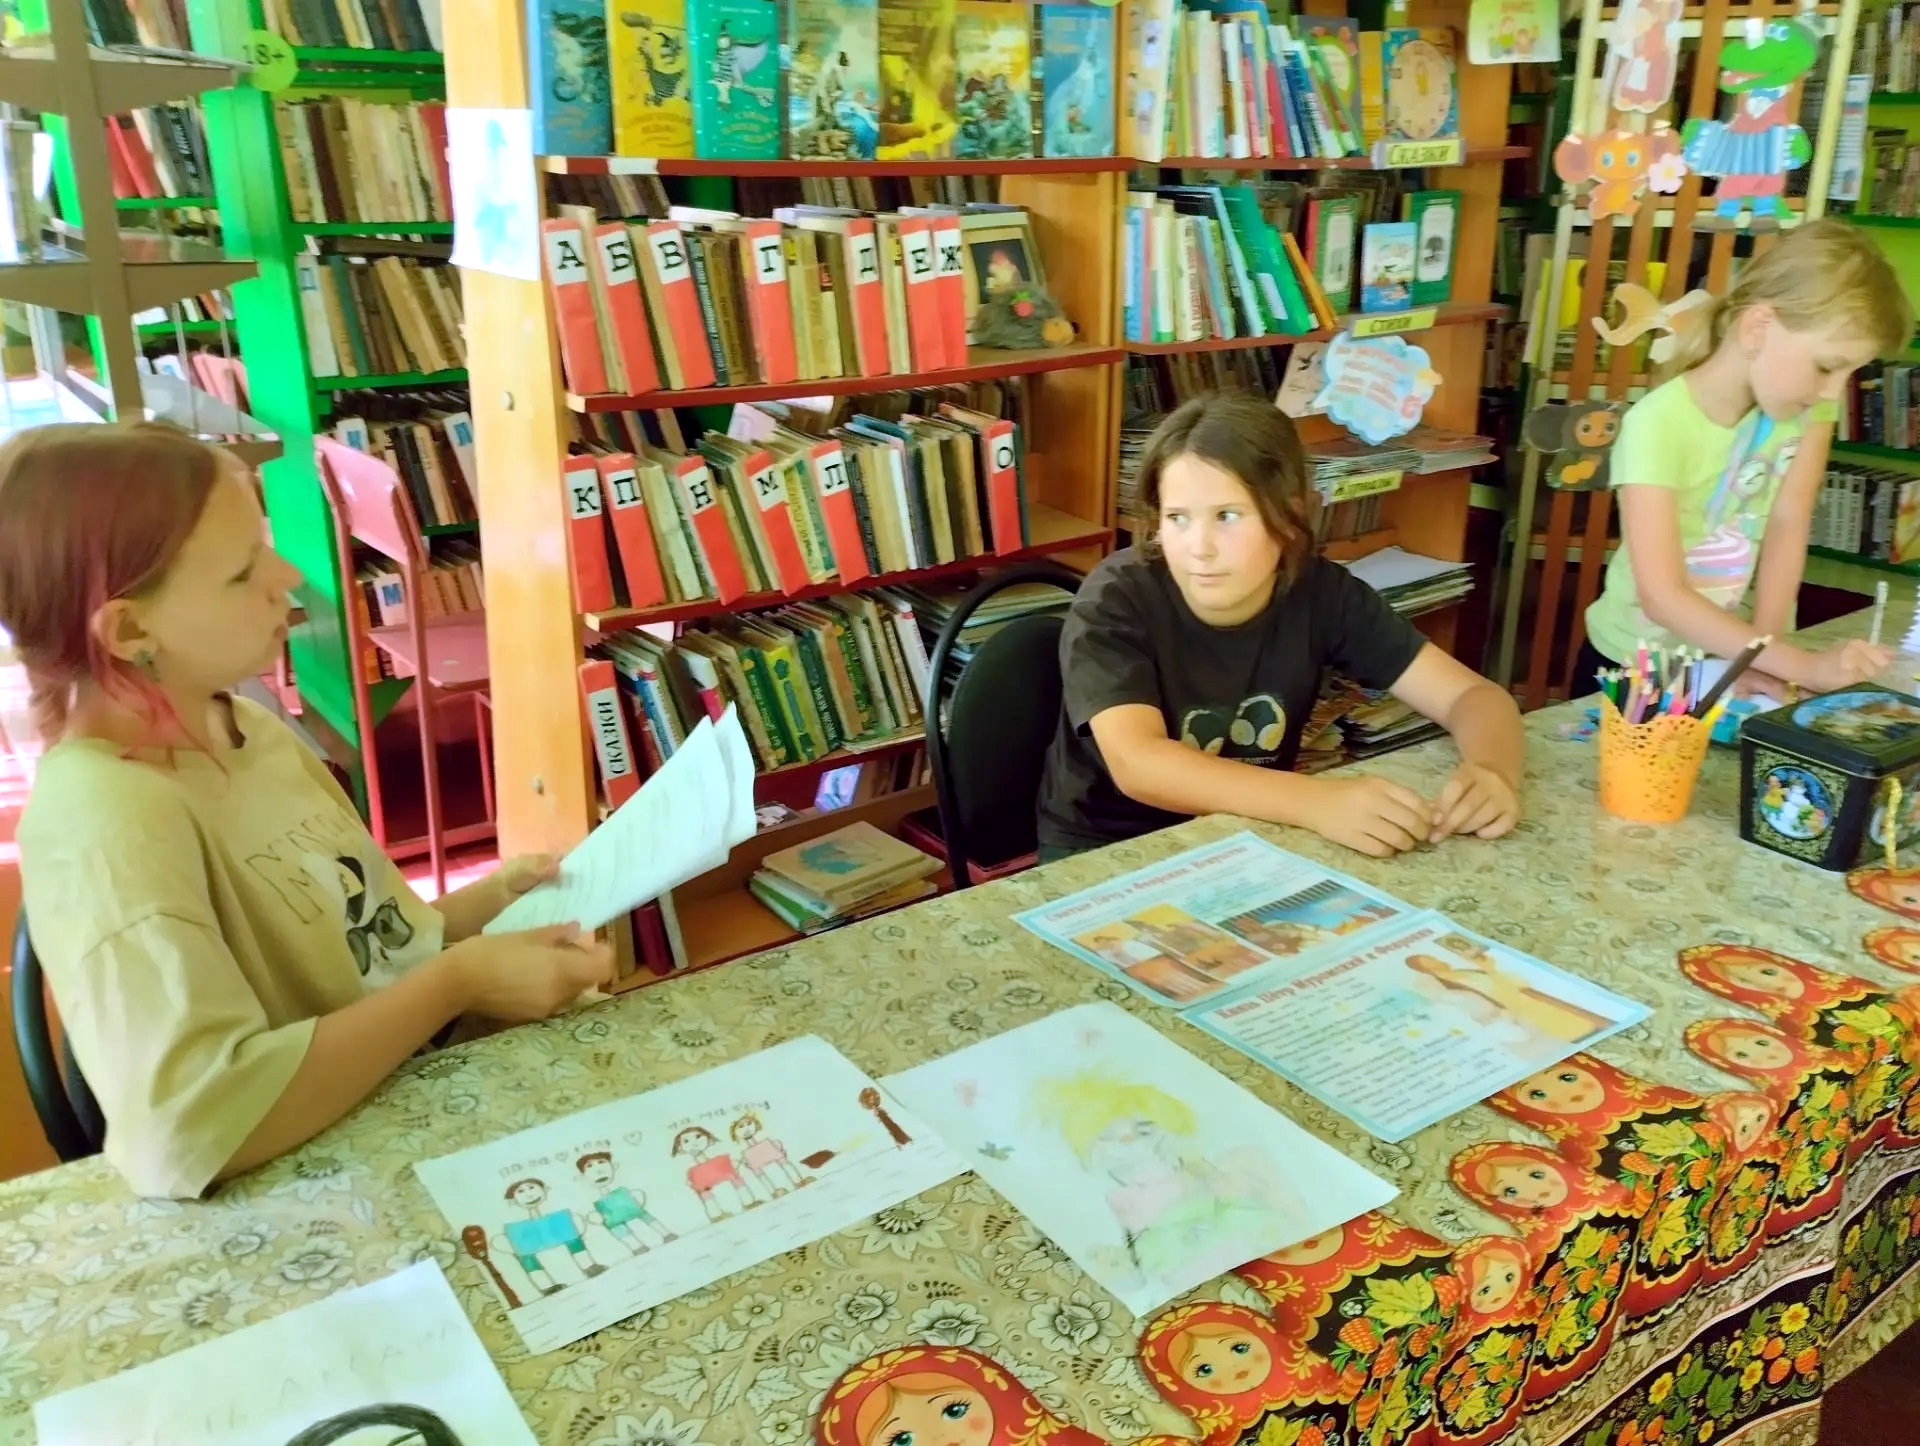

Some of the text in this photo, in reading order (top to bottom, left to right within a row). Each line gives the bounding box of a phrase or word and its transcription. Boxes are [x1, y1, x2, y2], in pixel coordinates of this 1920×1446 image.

[242, 44, 284, 65] 18+
[557, 240, 585, 270] А
[606, 241, 635, 272] Б
[658, 240, 687, 270] В
[759, 245, 782, 273] Г
[911, 247, 932, 274] Е
[940, 246, 963, 272] Ж
[996, 446, 1014, 470] О
[613, 476, 641, 505] П
[756, 470, 780, 497] М
[824, 463, 846, 490] Л
[573, 485, 599, 513] К
[689, 480, 713, 509] Н
[597, 701, 627, 774] СКАЗКИ
